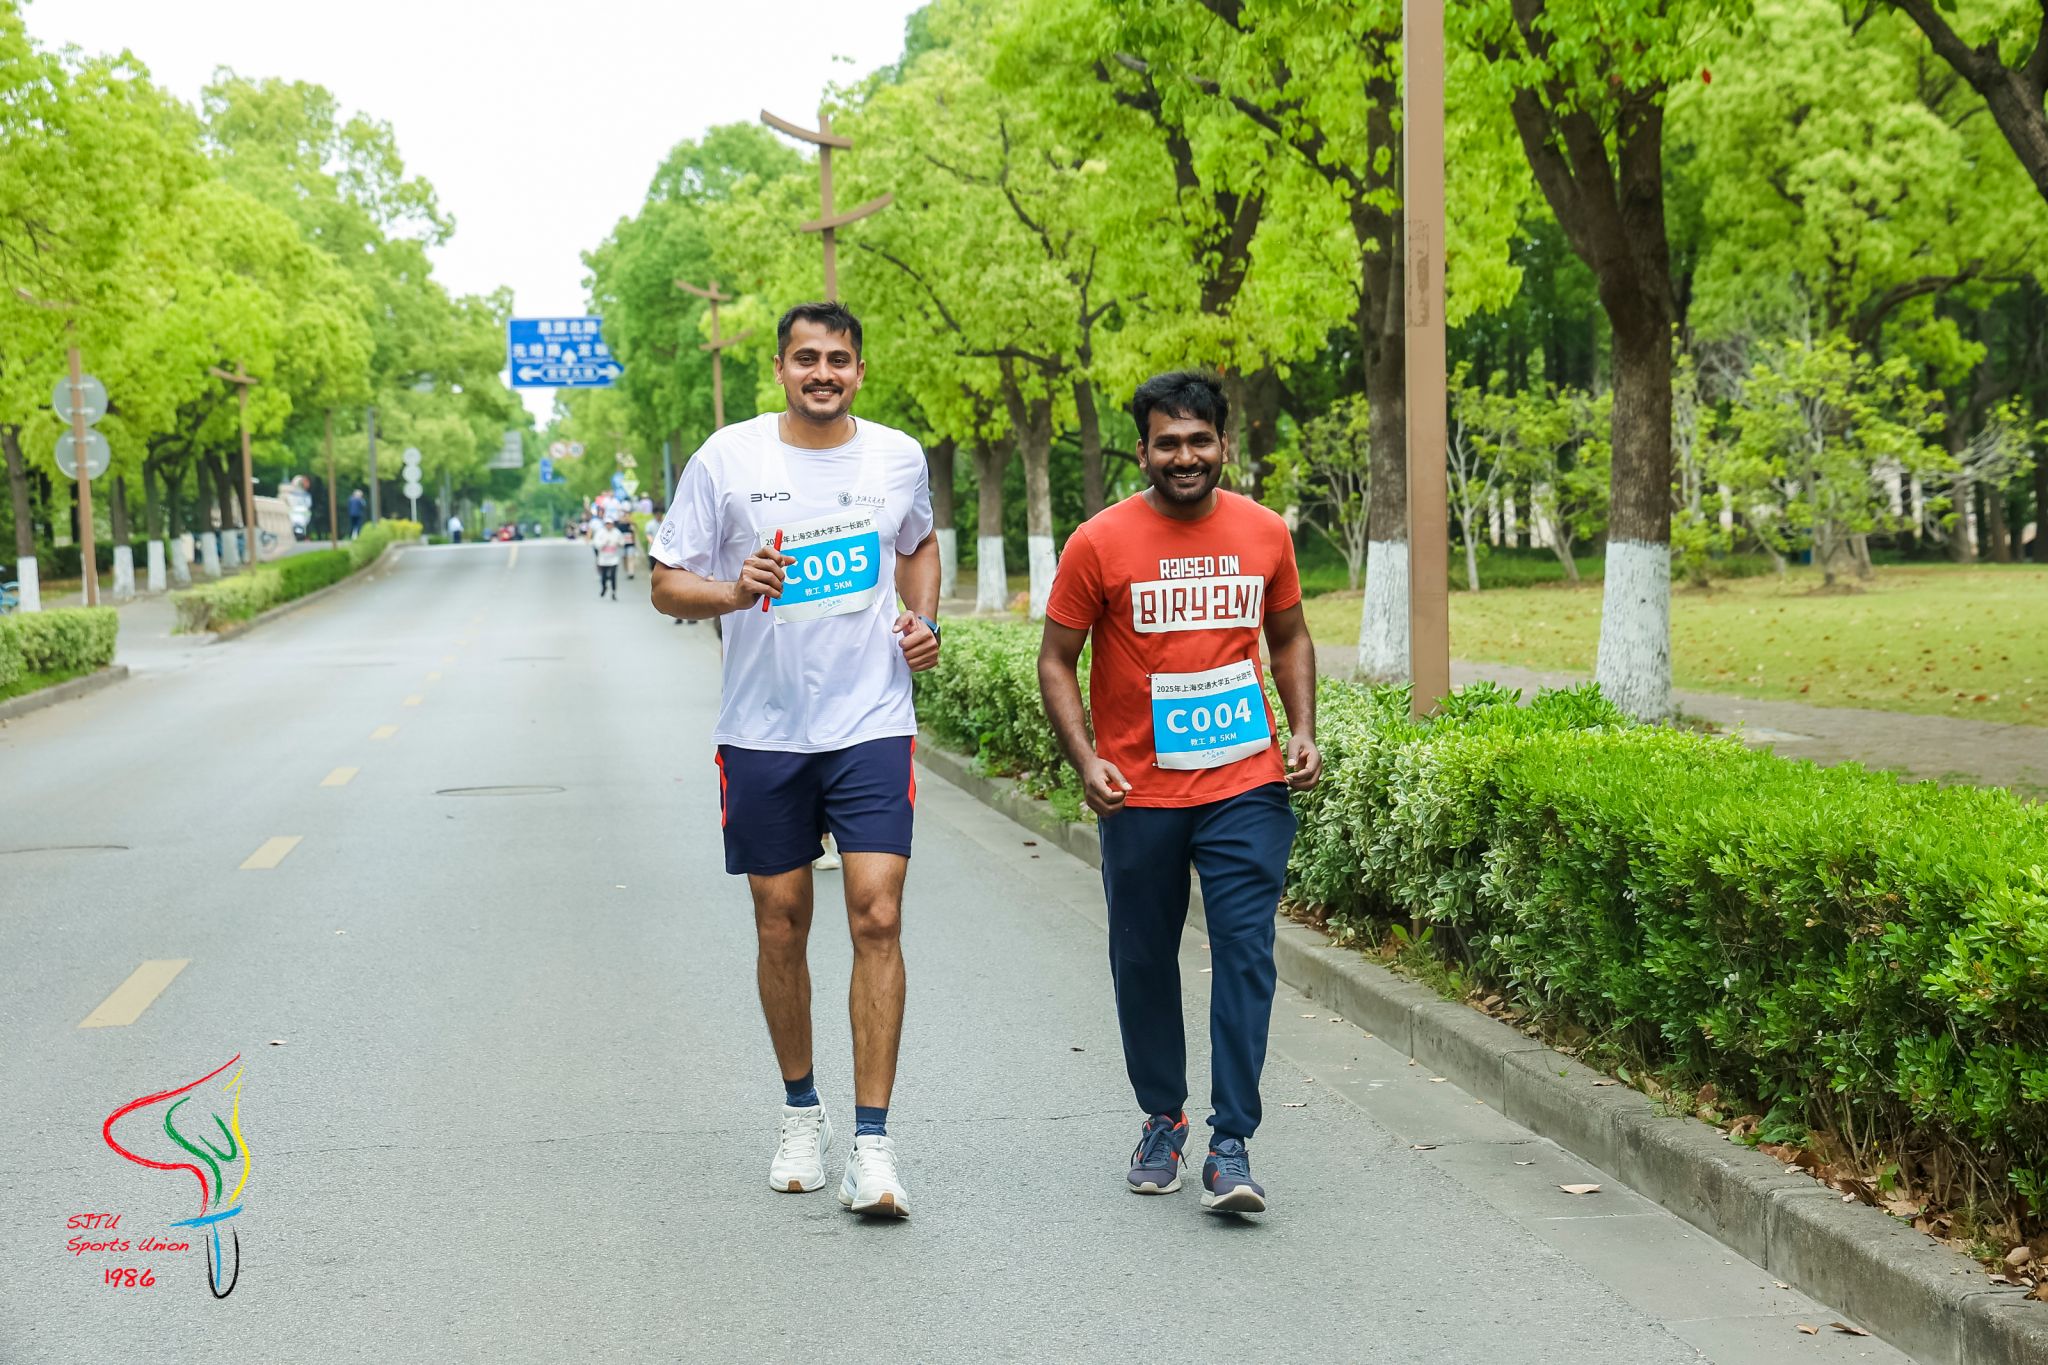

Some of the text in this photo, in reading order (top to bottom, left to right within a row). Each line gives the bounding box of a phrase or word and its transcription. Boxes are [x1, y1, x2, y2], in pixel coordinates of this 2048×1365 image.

[750, 492, 791, 503] BYD
[766, 518, 871, 546] 20年上海交通大学五一长跑节
[781, 545, 868, 585] C005
[1218, 555, 1240, 576] ON
[805, 580, 853, 597] 教工 男 5KM
[1156, 670, 1253, 693] 2025年上海交通大学五一长跑节
[1166, 697, 1252, 734] C004
[1190, 732, 1237, 747] 教工 男 5KM
